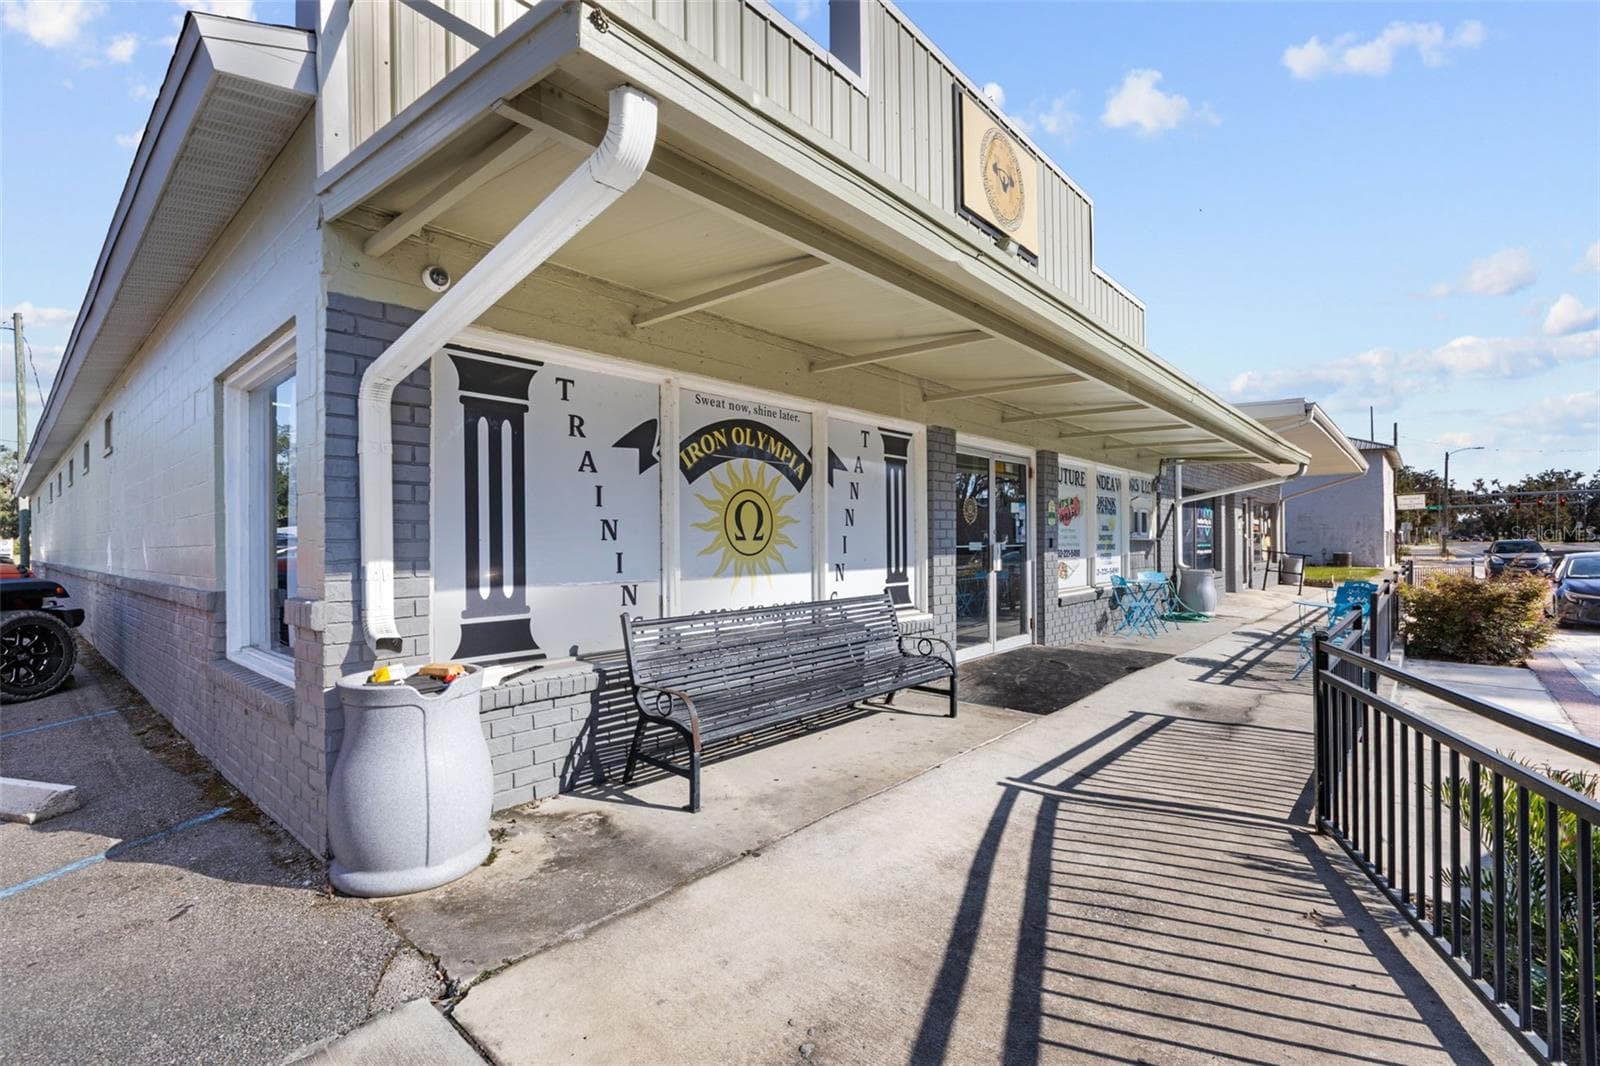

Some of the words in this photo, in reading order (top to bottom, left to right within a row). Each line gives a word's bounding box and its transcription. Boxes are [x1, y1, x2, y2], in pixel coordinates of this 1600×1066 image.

[695, 393, 725, 409] Sweat
[728, 401, 752, 415] now,
[753, 406, 778, 419] shine
[779, 409, 801, 422] later.
[680, 429, 728, 469] IRON
[731, 426, 805, 480] OLYMPIA
